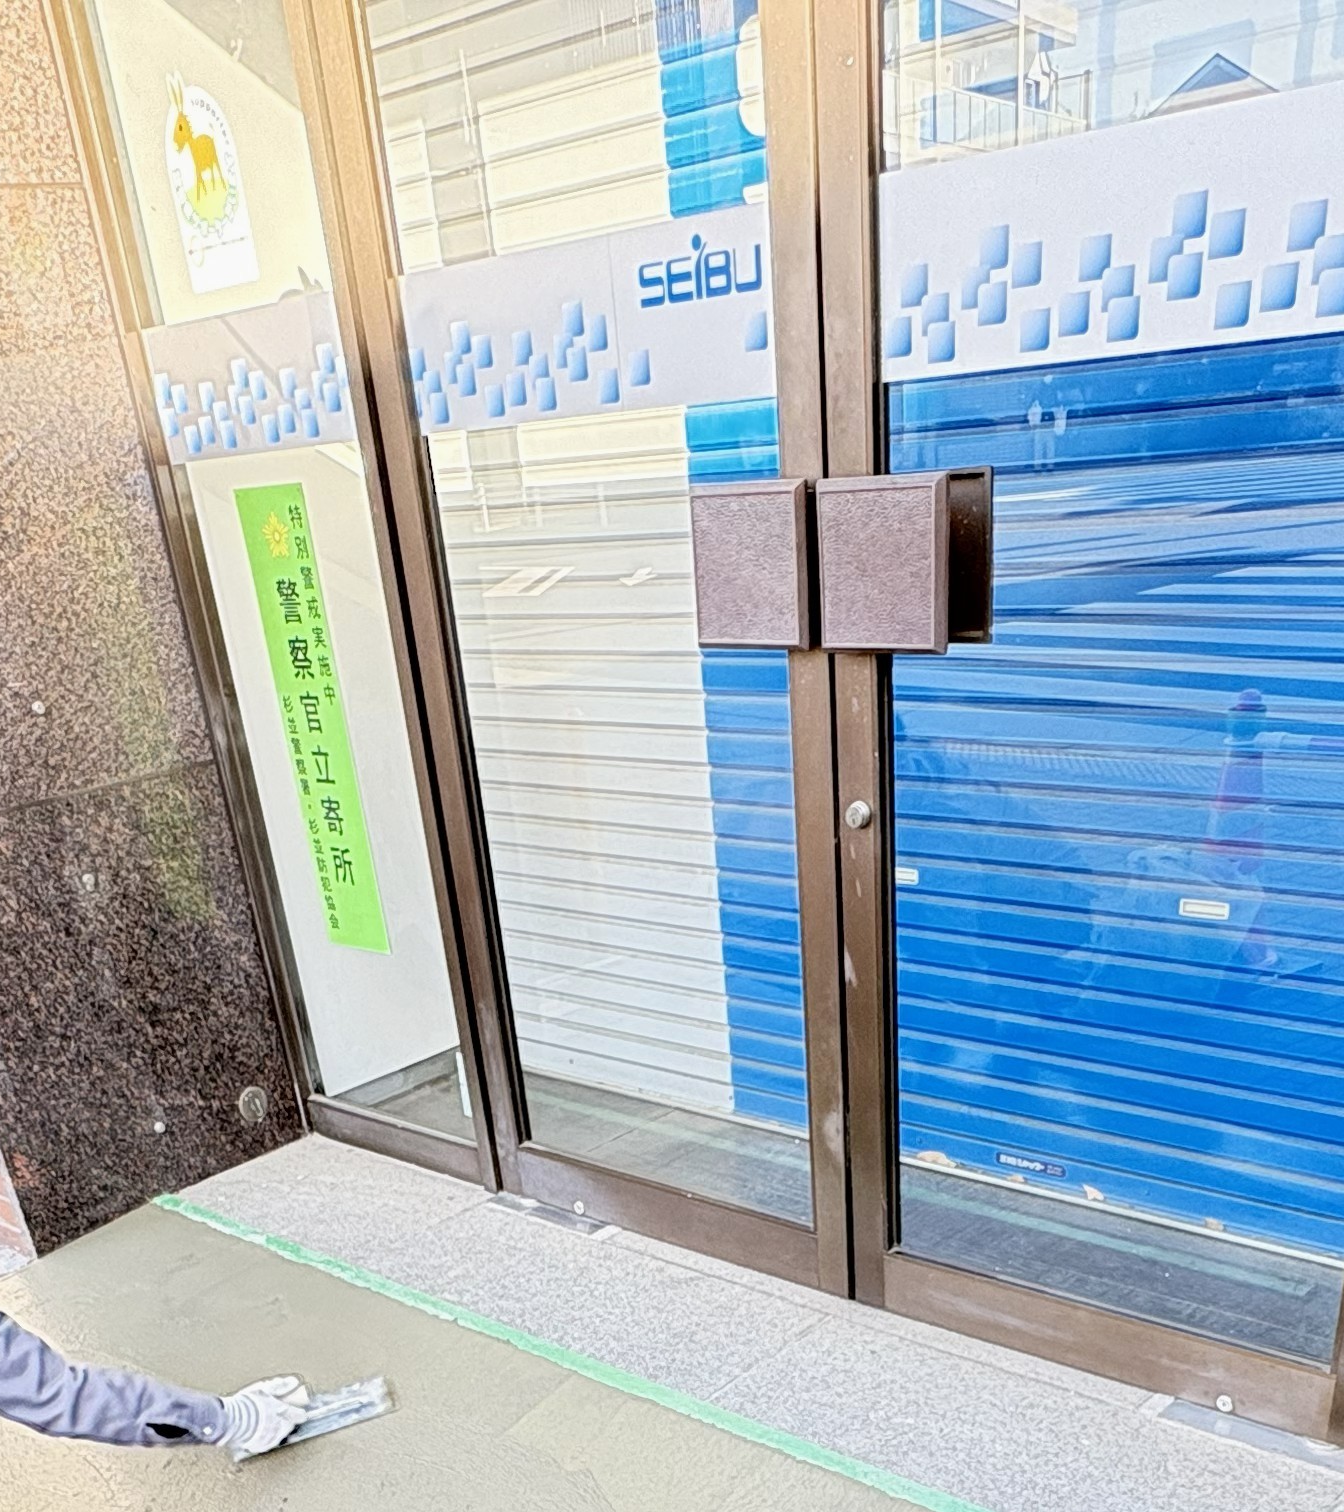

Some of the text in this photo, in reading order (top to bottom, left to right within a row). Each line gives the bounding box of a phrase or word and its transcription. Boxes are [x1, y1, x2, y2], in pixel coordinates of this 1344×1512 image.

[275, 577, 355, 887] 警察官立寄所
[288, 504, 337, 706] 特別警戒実施中
